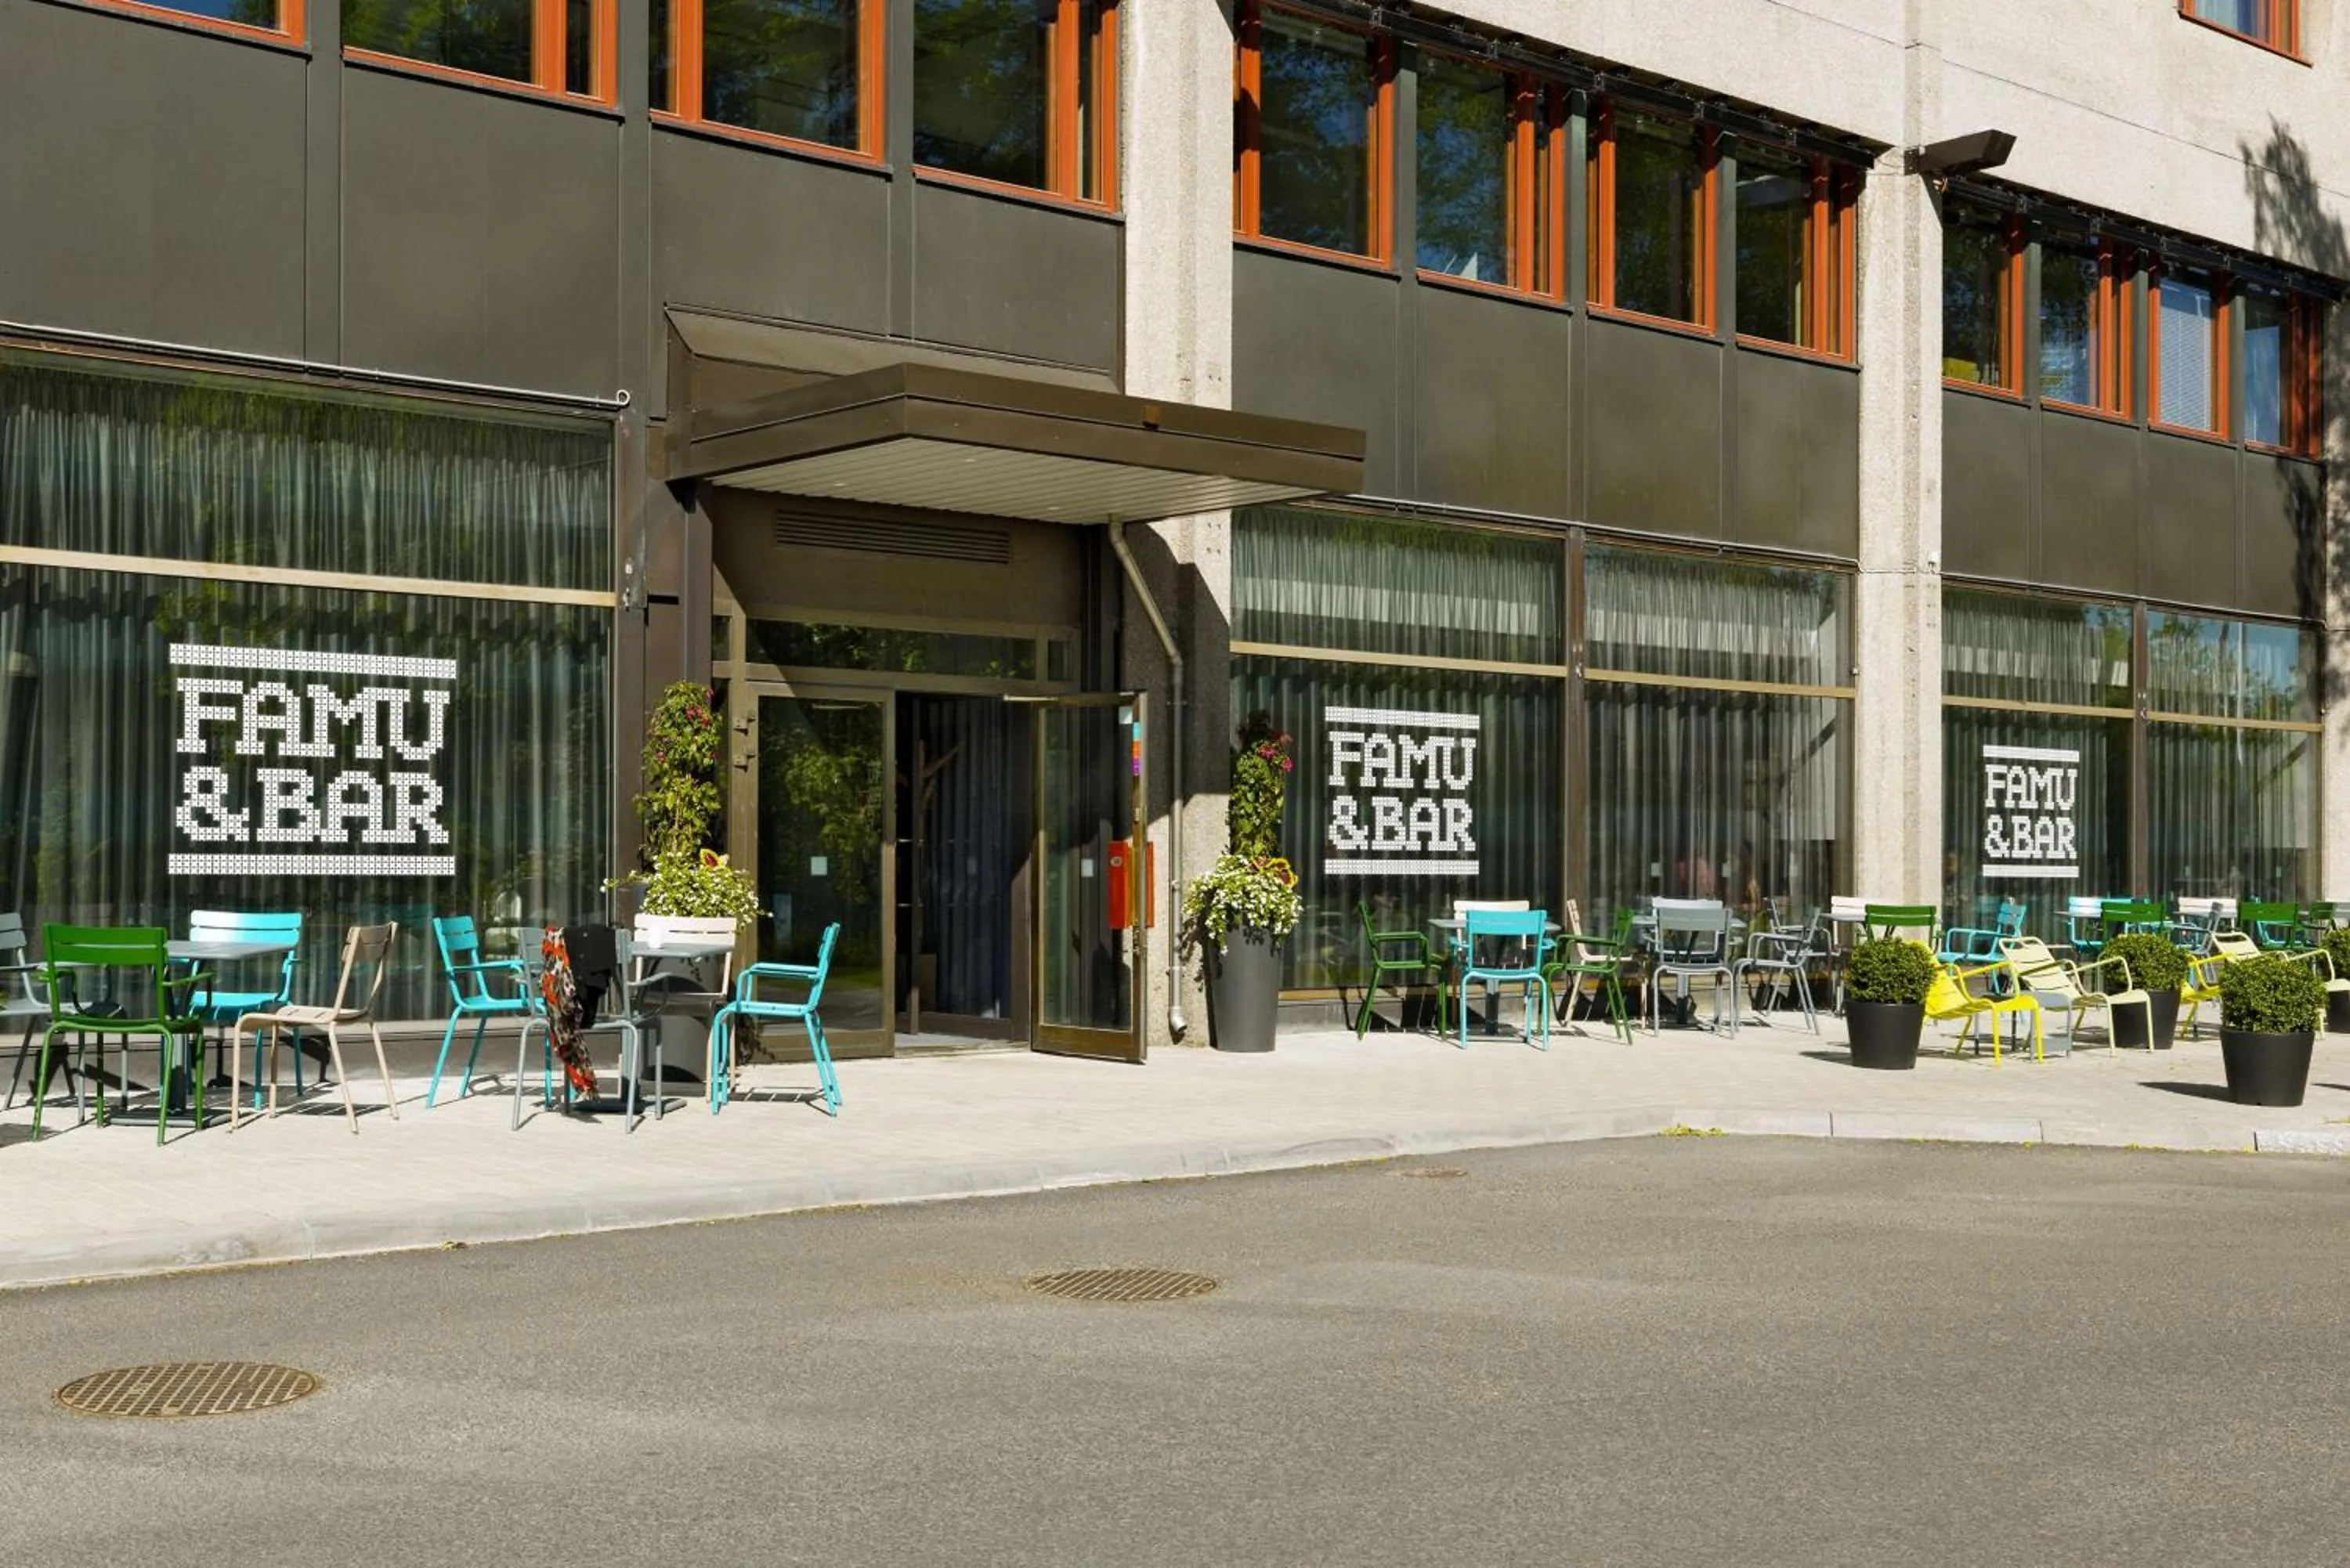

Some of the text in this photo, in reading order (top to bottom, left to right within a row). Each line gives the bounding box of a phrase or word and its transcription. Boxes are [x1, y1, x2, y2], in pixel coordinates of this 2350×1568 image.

[176, 677, 450, 760] FAMU
[1329, 732, 1477, 789] FAMU
[1985, 764, 2078, 810] FAMU
